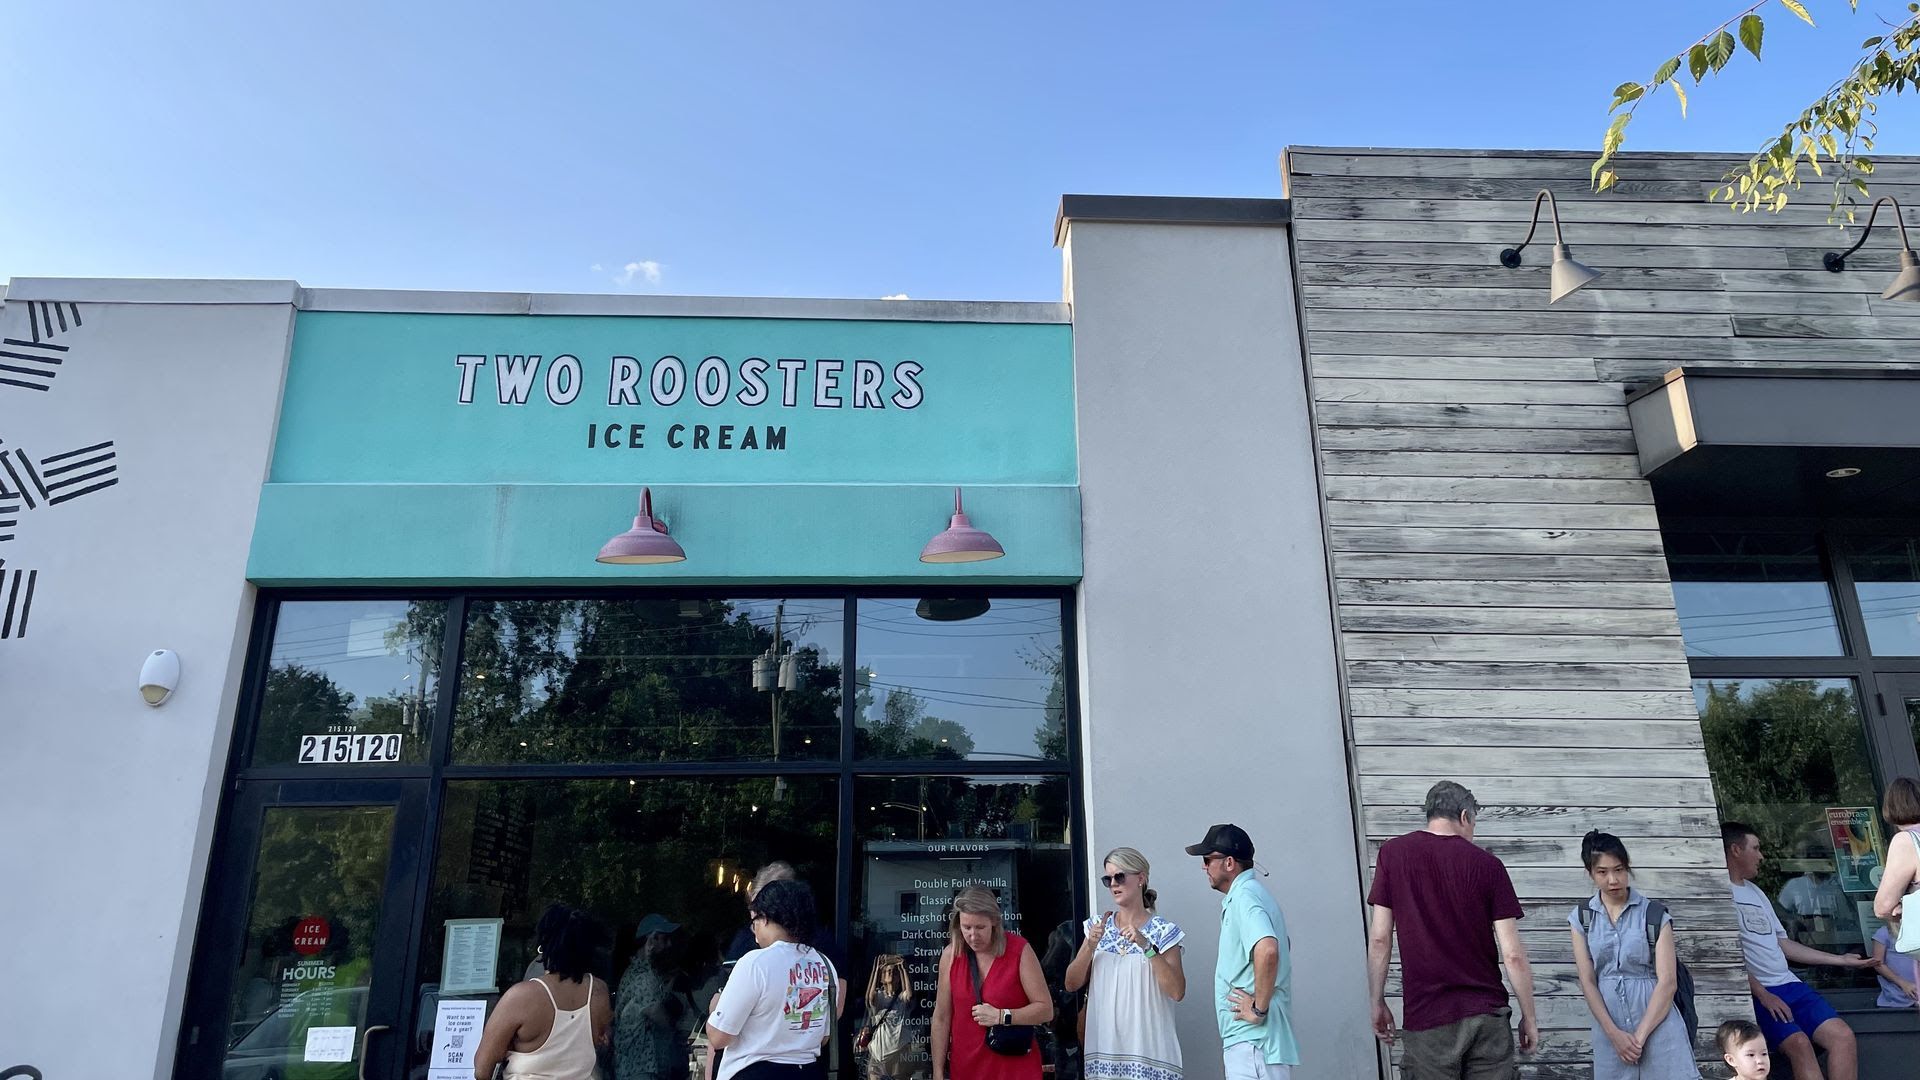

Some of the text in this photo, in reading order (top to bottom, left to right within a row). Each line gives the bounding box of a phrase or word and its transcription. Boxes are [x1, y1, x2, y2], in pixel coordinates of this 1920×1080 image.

[455, 354, 925, 410] TWO ROOSTERS
[587, 423, 788, 450] ICE CREAM
[301, 735, 400, 762] 215 120
[927, 844, 990, 852] OUR FLAVORS
[914, 878, 949, 889] Double
[951, 877, 971, 888] Fold
[919, 895, 952, 905] Classic
[900, 912, 947, 924] Slingshot
[304, 925, 320, 933] ICE
[901, 930, 923, 939] Dark
[294, 937, 327, 945] CREAM
[282, 966, 336, 980] HOURS
[908, 963, 929, 974] Sola
